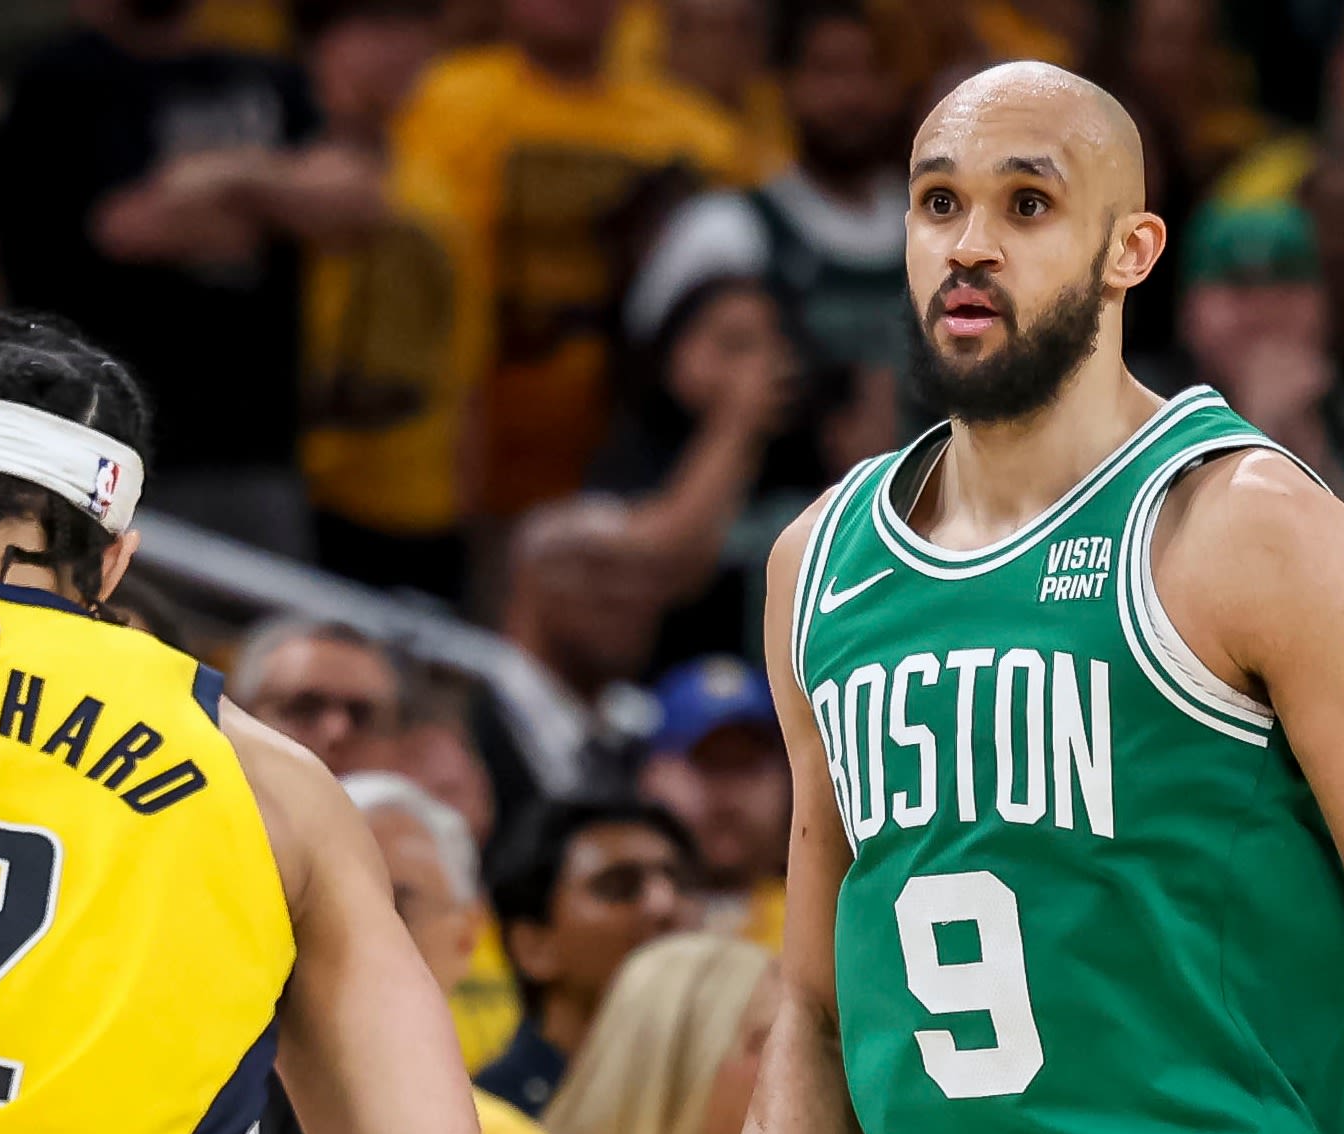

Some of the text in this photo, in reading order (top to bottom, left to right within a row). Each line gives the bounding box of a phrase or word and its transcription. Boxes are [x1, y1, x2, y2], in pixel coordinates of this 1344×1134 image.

[1039, 572, 1109, 603] PRINT
[1047, 536, 1113, 575] VISTA
[811, 647, 1115, 858] BOSTON
[894, 870, 1045, 1100] 9
